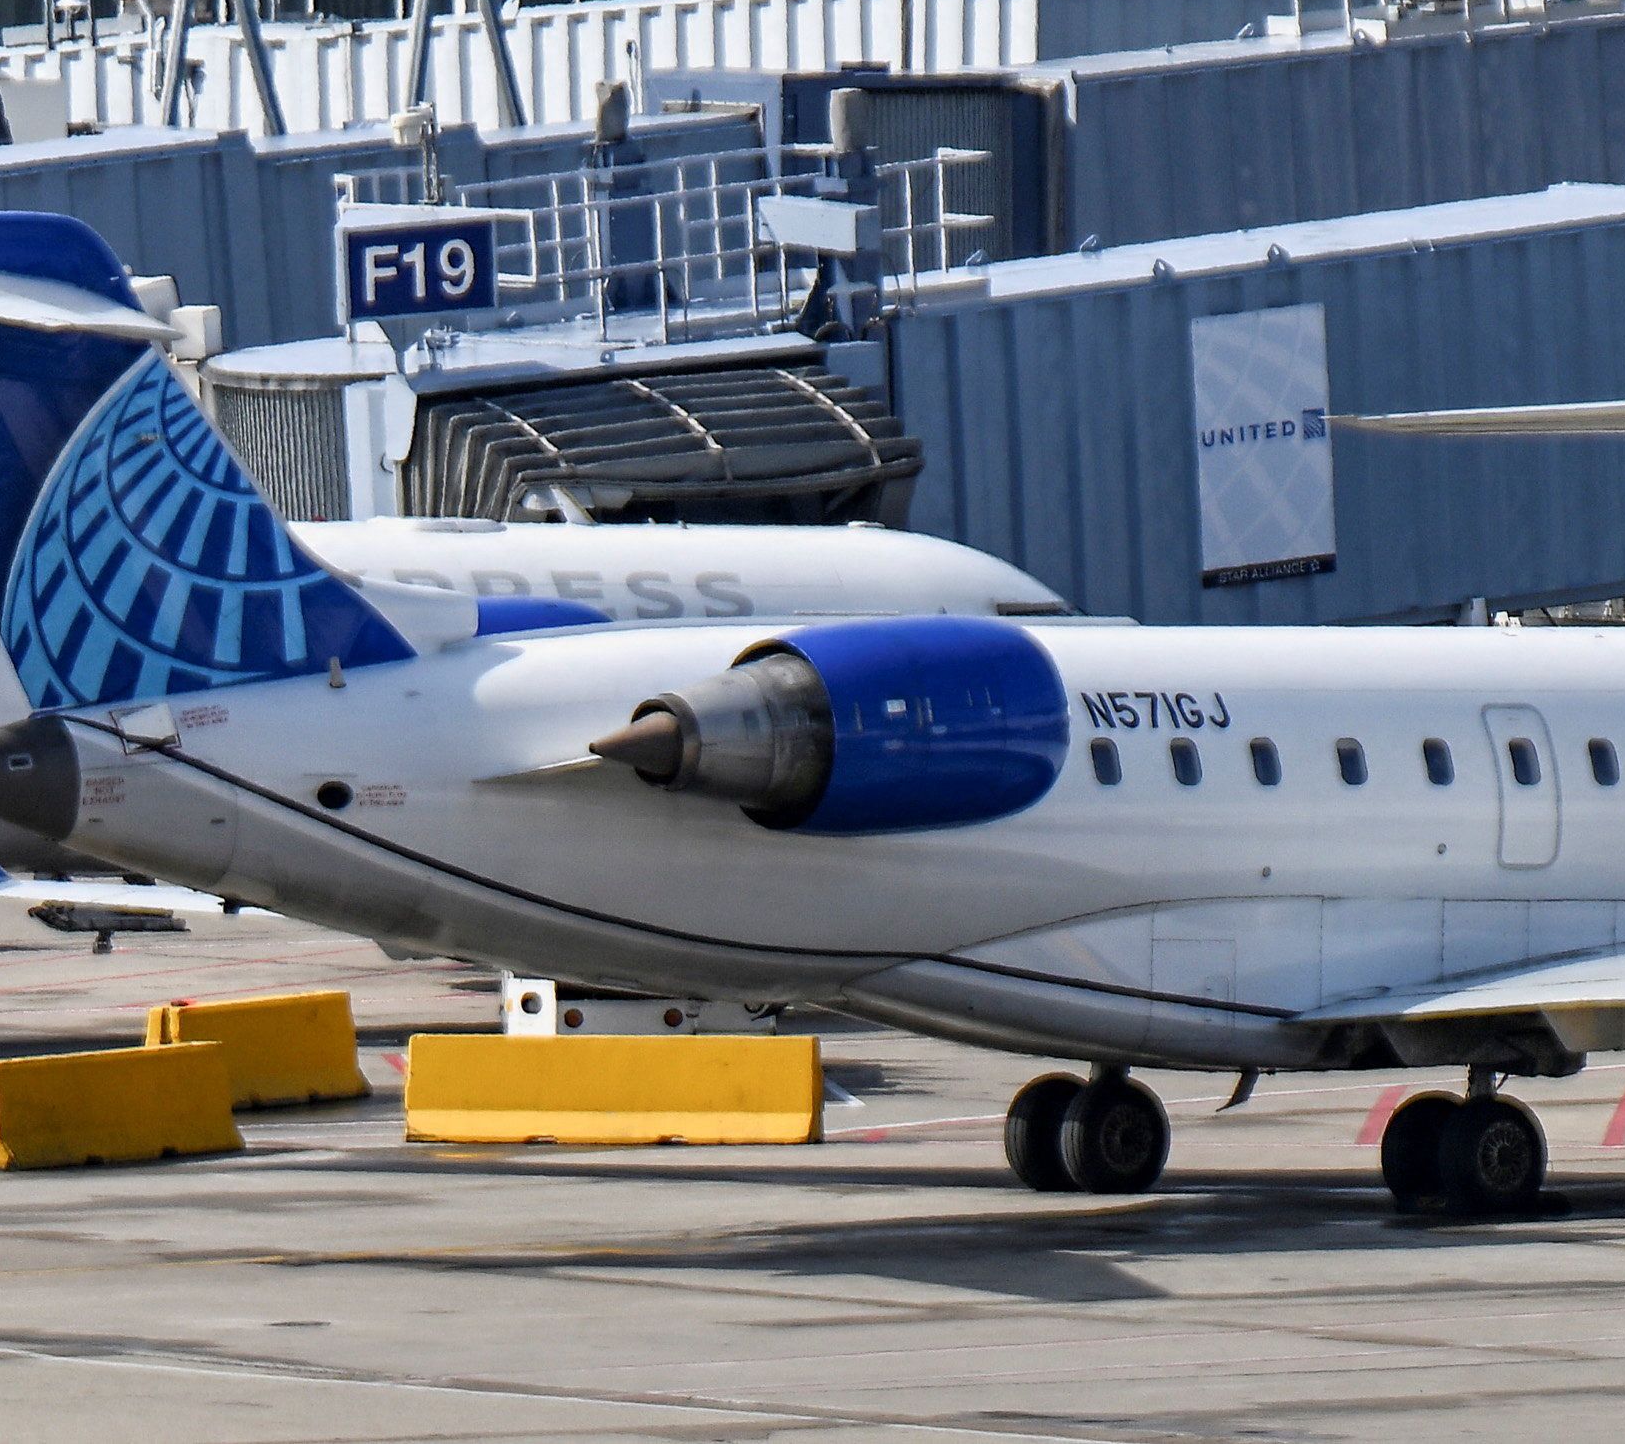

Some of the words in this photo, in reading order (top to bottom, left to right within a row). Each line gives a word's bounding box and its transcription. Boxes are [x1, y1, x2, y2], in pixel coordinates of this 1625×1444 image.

[364, 238, 475, 302] F19
[1202, 420, 1296, 447] UNITED
[1080, 692, 1232, 729] N571GJ
